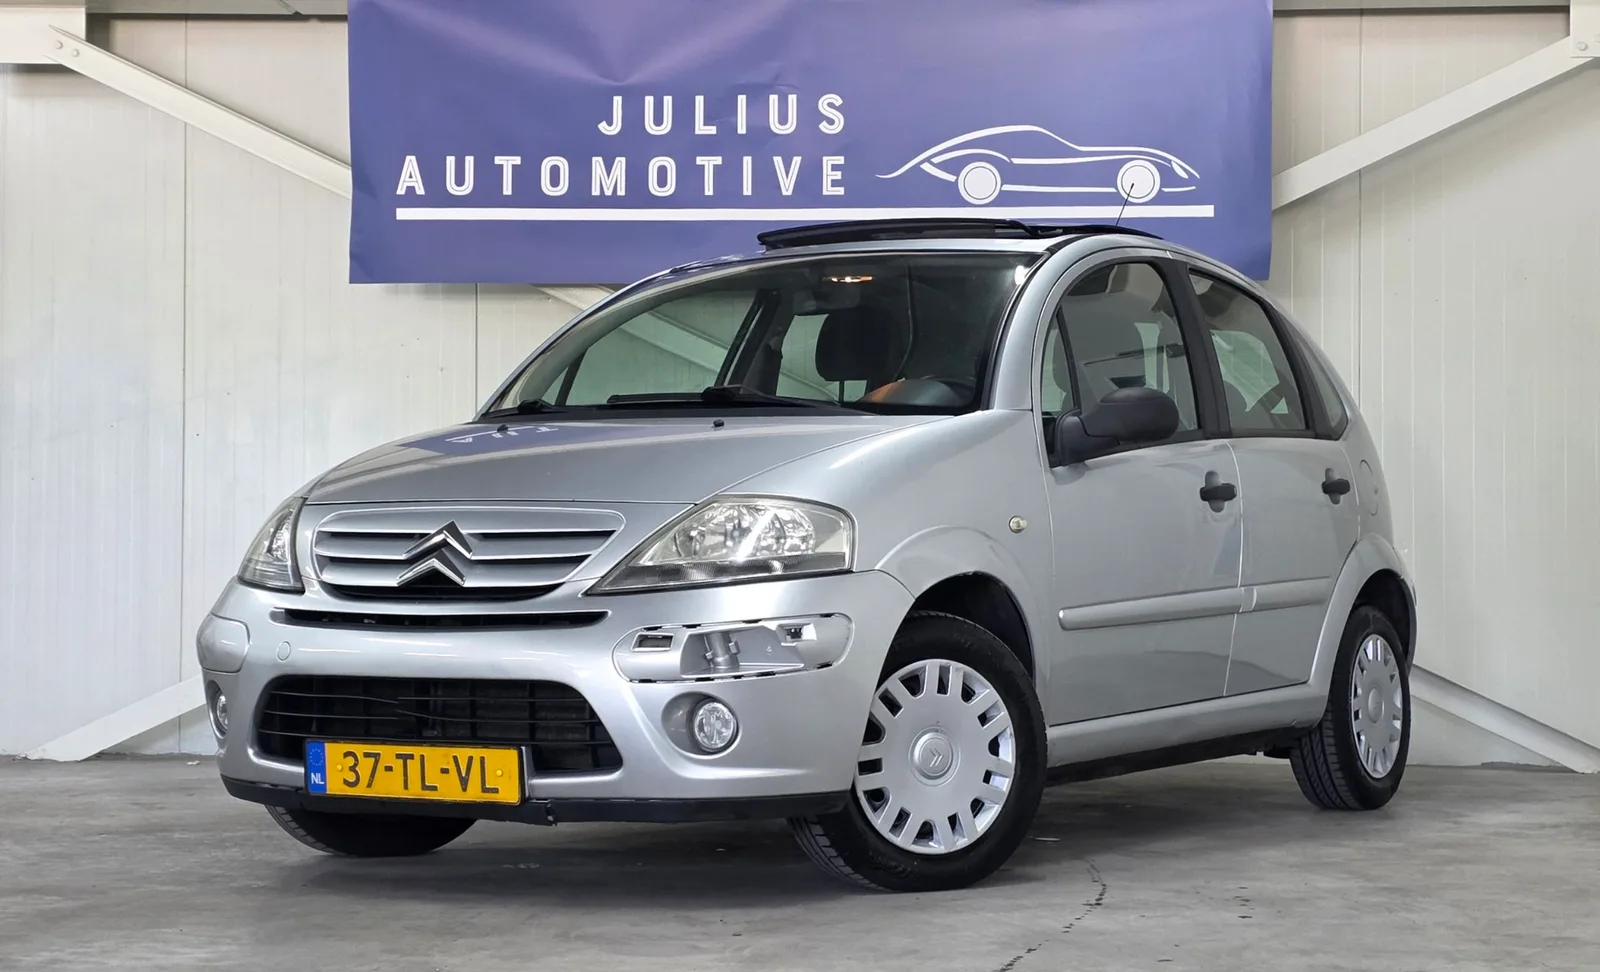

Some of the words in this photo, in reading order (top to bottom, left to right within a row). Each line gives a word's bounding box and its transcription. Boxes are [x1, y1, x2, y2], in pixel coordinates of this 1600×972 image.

[598, 93, 846, 136] JULIUS
[396, 154, 846, 197] AUTOMOTIVE
[310, 772, 325, 785] NL
[342, 750, 500, 794] 37-TL-VL
